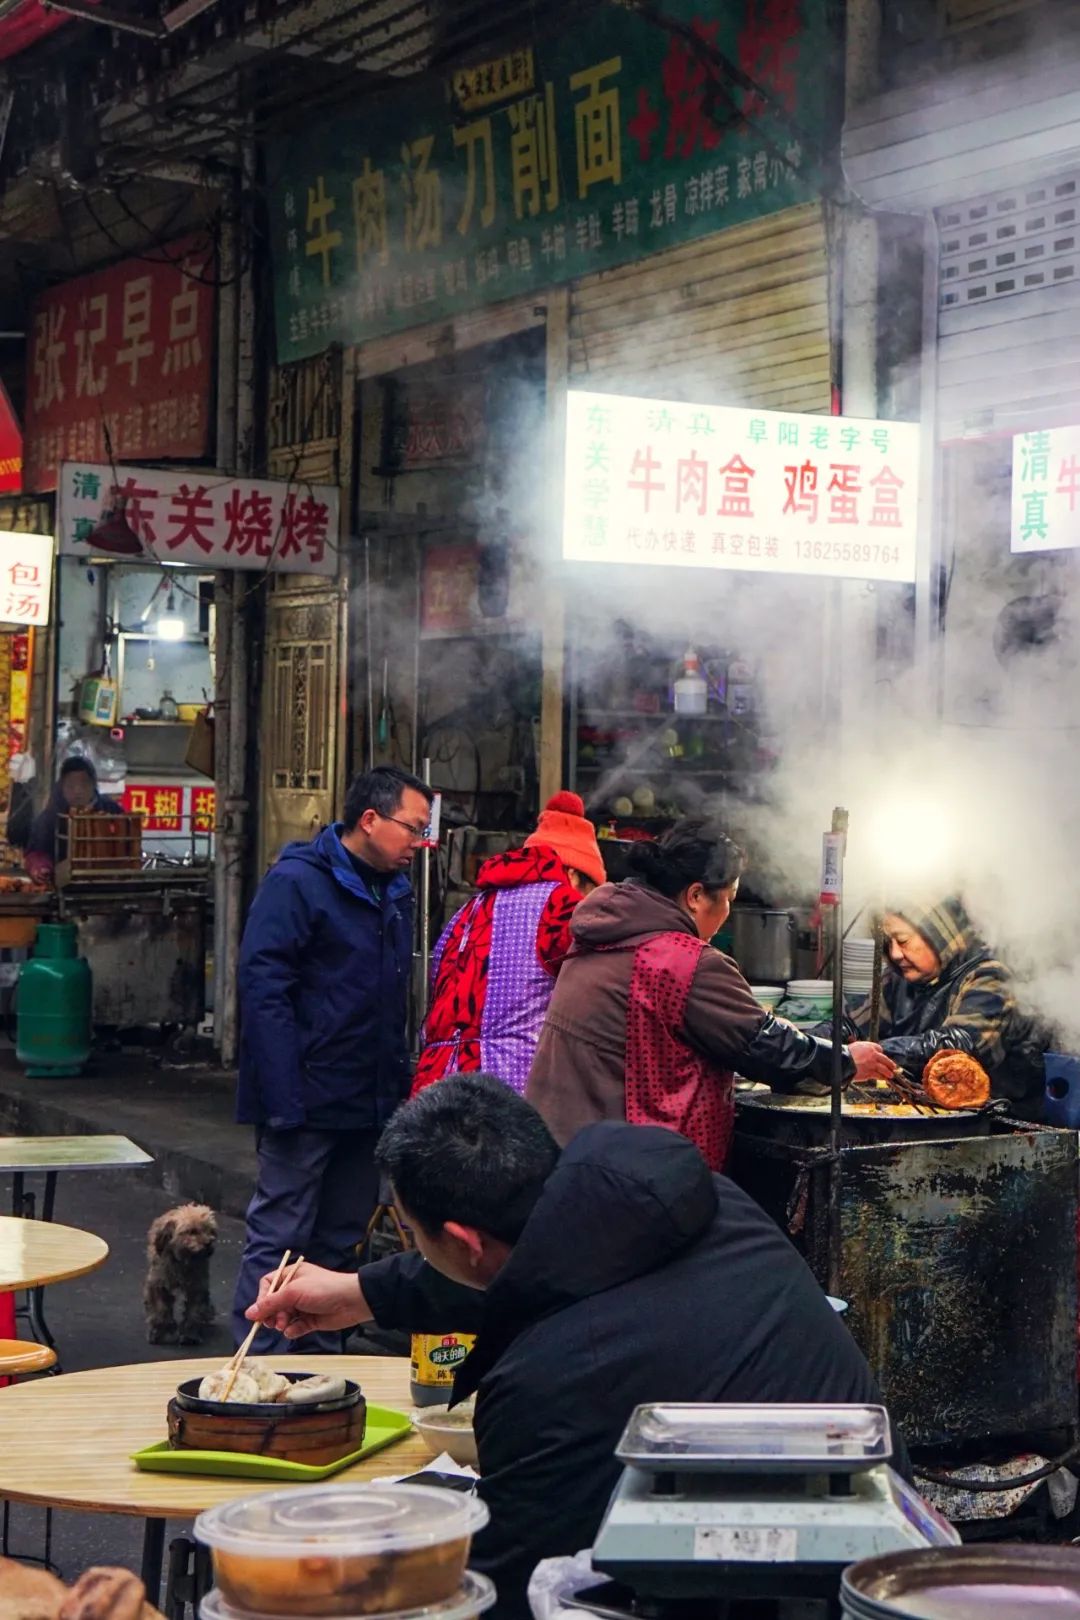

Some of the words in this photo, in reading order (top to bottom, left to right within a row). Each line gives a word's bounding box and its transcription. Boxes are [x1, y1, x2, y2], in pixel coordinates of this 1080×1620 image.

[305, 56, 622, 290] 牛肉汤刀削面
[33, 256, 204, 411] 张记早点
[646, 407, 717, 437] 清真
[746, 418, 891, 455] 阜阳老字号
[72, 471, 101, 544] 清真
[109, 476, 330, 565] 东关烧烤
[627, 445, 756, 519] 牛肉盒
[781, 458, 906, 529] 鸡蛋盒
[1019, 431, 1051, 542] 清真
[710, 531, 780, 560] 真空包装
[130, 790, 178, 829] 马糊
